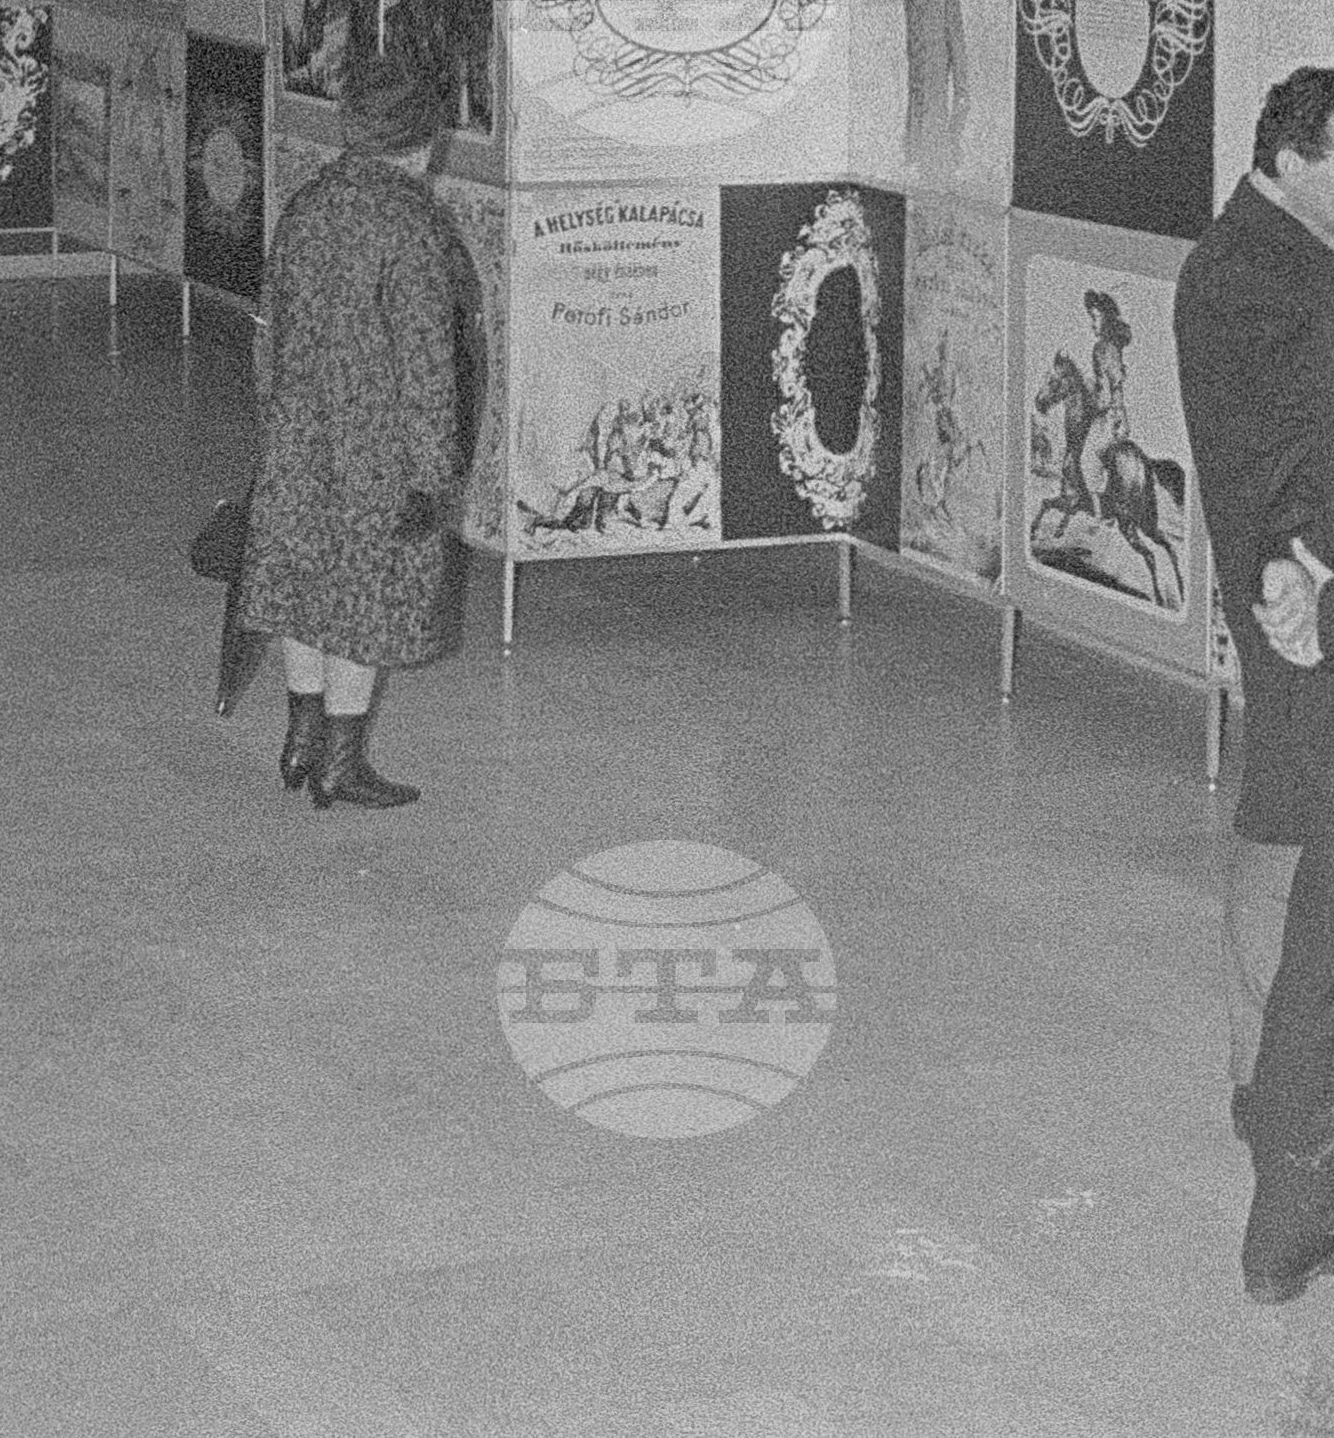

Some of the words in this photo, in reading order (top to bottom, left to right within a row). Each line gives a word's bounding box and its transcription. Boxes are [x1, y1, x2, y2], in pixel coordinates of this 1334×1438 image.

[534, 220, 546, 238] A
[619, 200, 704, 228] KALAPÁCSA
[619, 301, 690, 326] Sándor
